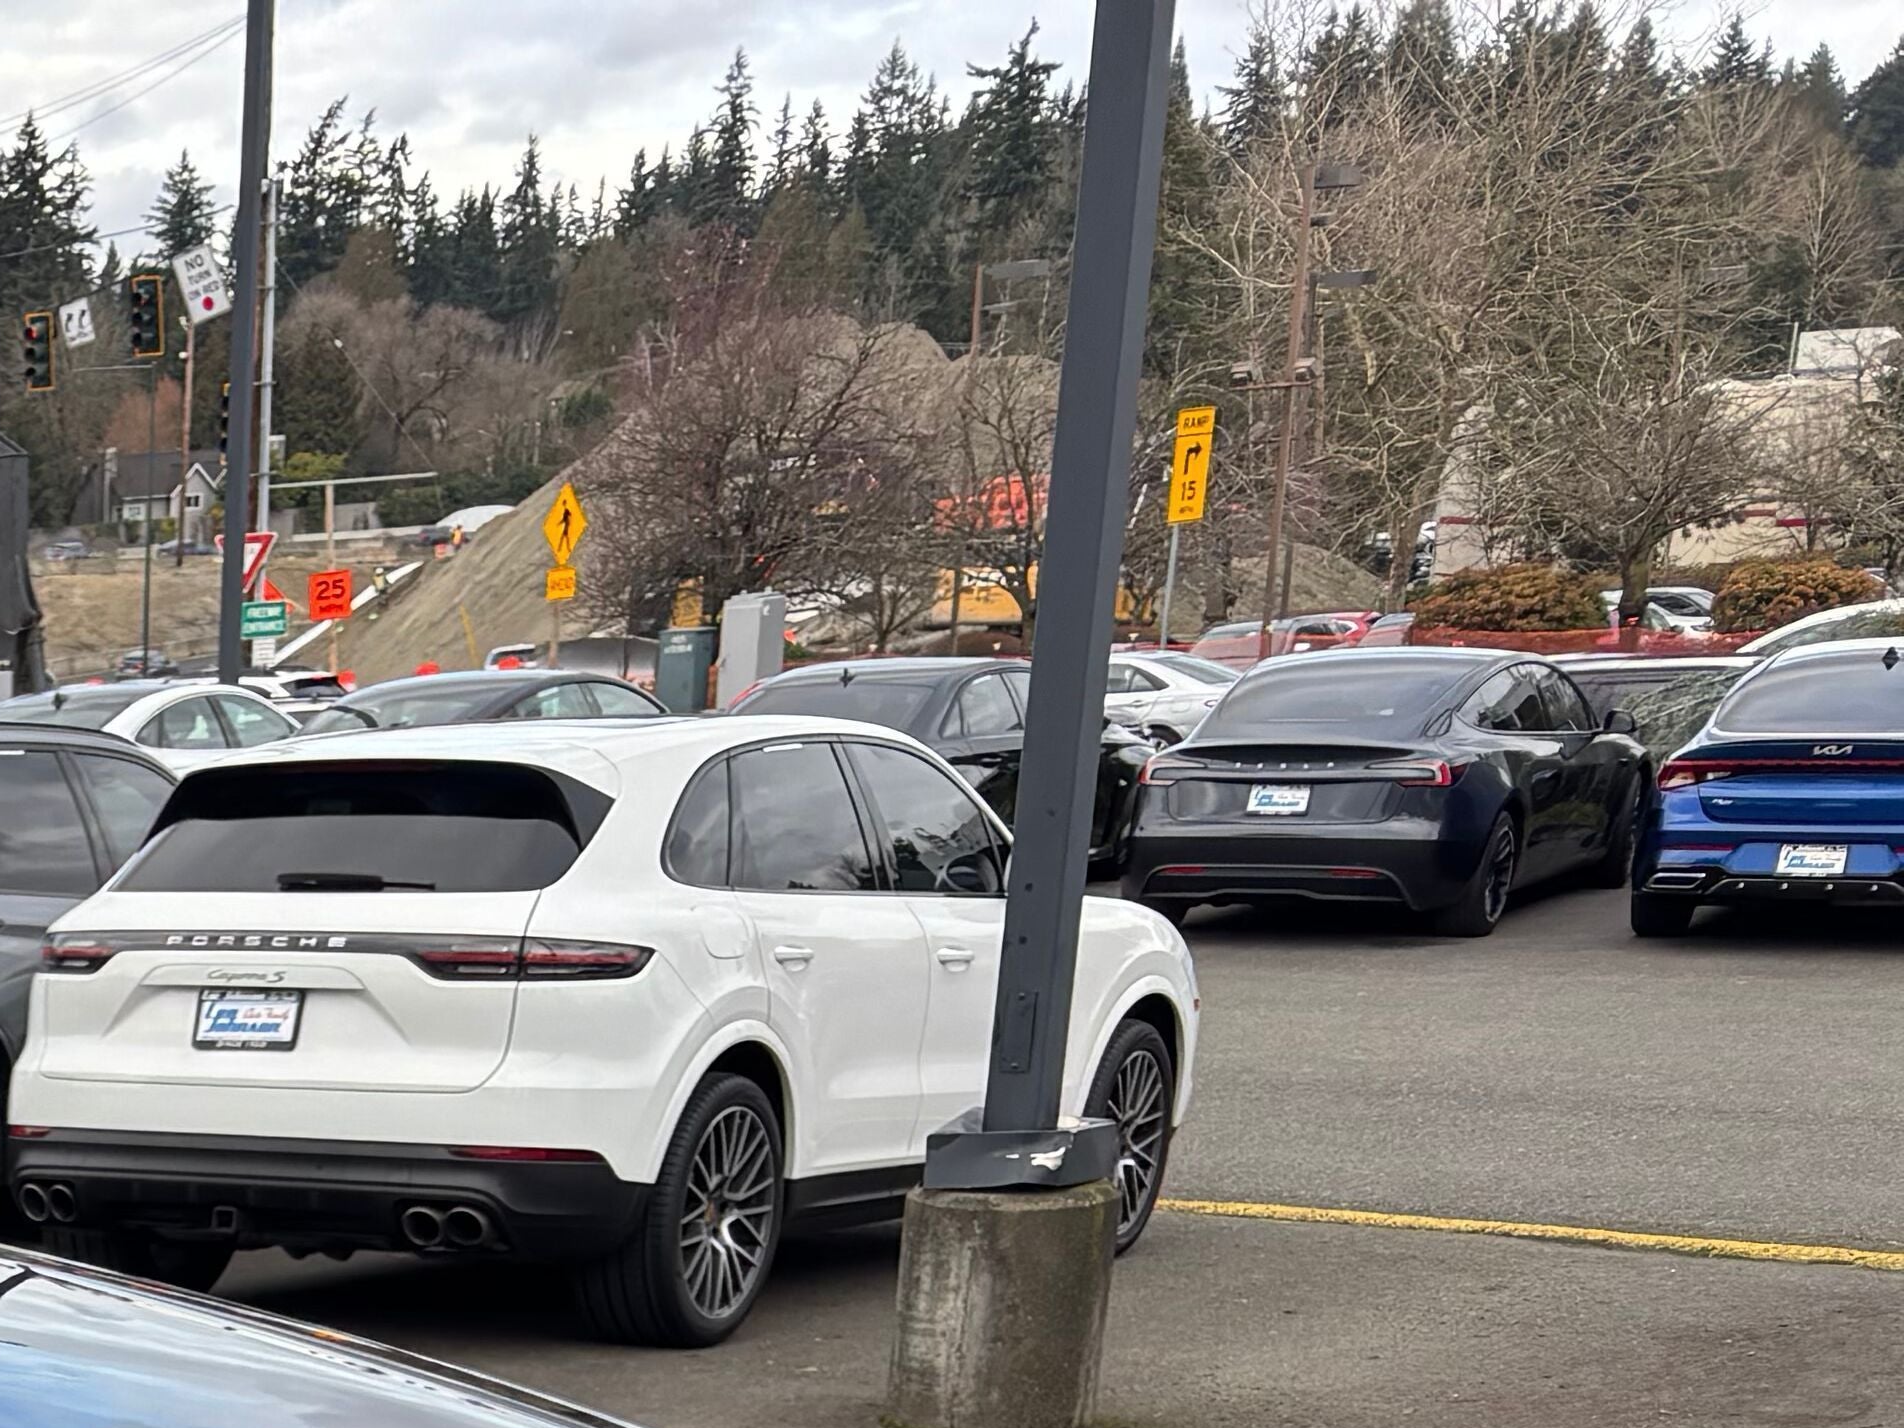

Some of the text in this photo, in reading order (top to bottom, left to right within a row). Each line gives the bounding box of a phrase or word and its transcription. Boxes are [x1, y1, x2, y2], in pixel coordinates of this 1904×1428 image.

[184, 254, 204, 272] NO
[1181, 481, 1197, 501] 15
[316, 578, 345, 600] 25
[166, 935, 347, 948] PORSCHE
[266, 971, 286, 983] S
